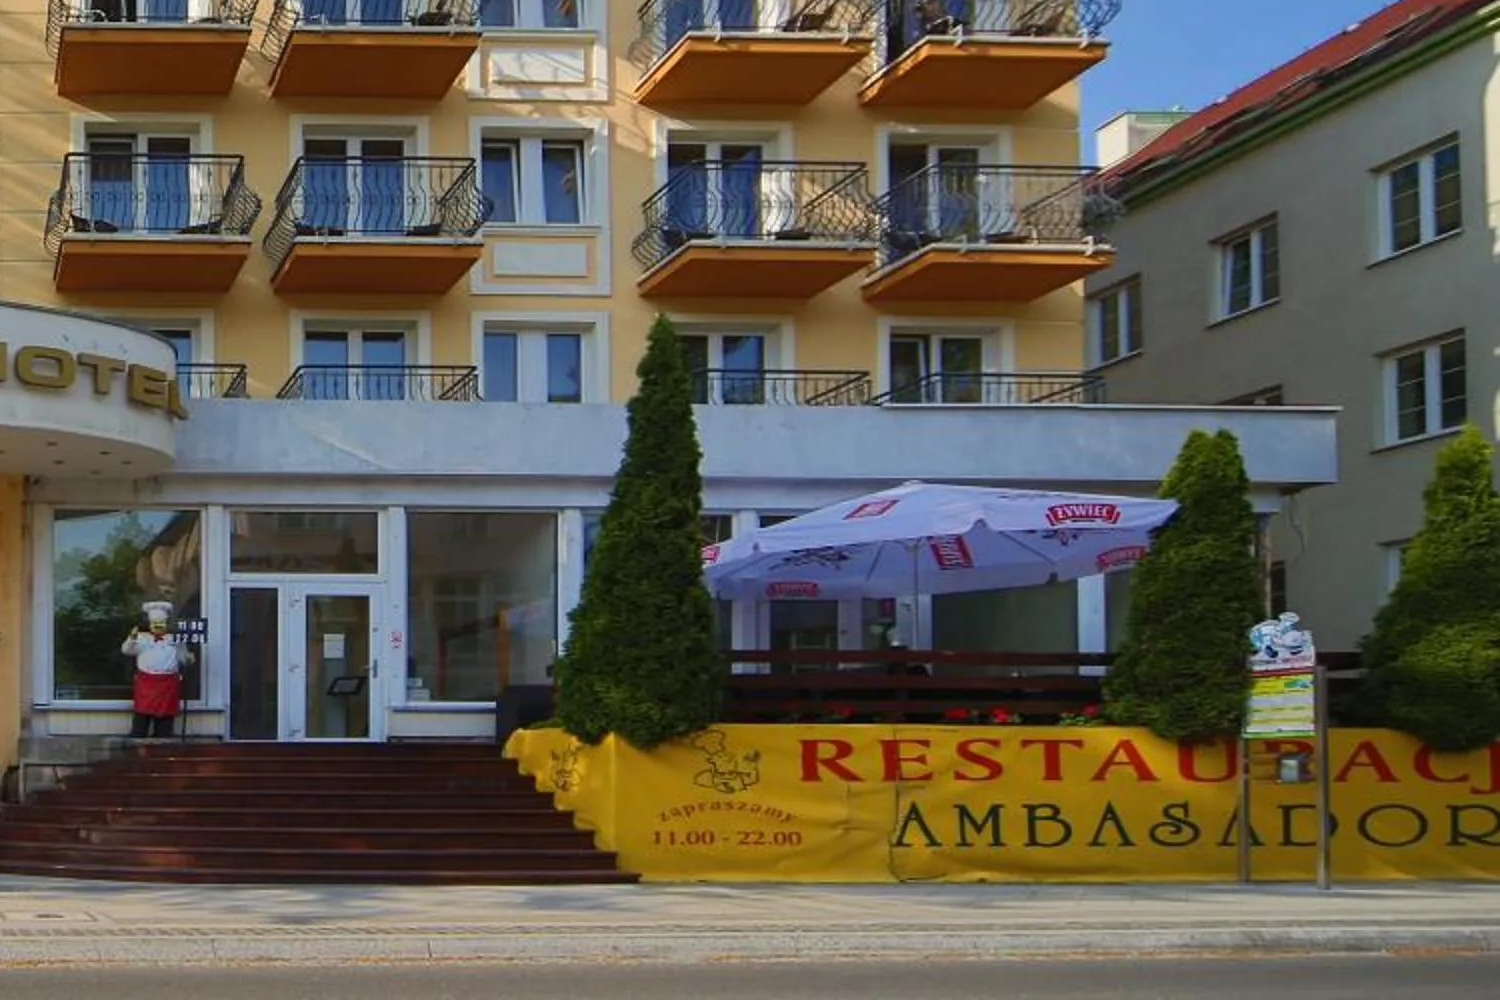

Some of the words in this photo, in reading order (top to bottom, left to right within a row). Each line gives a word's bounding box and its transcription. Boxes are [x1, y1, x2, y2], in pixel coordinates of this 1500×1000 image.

[659, 800, 797, 823] zapraszamy
[654, 830, 715, 846] 11.00
[736, 830, 802, 846] 22.00
